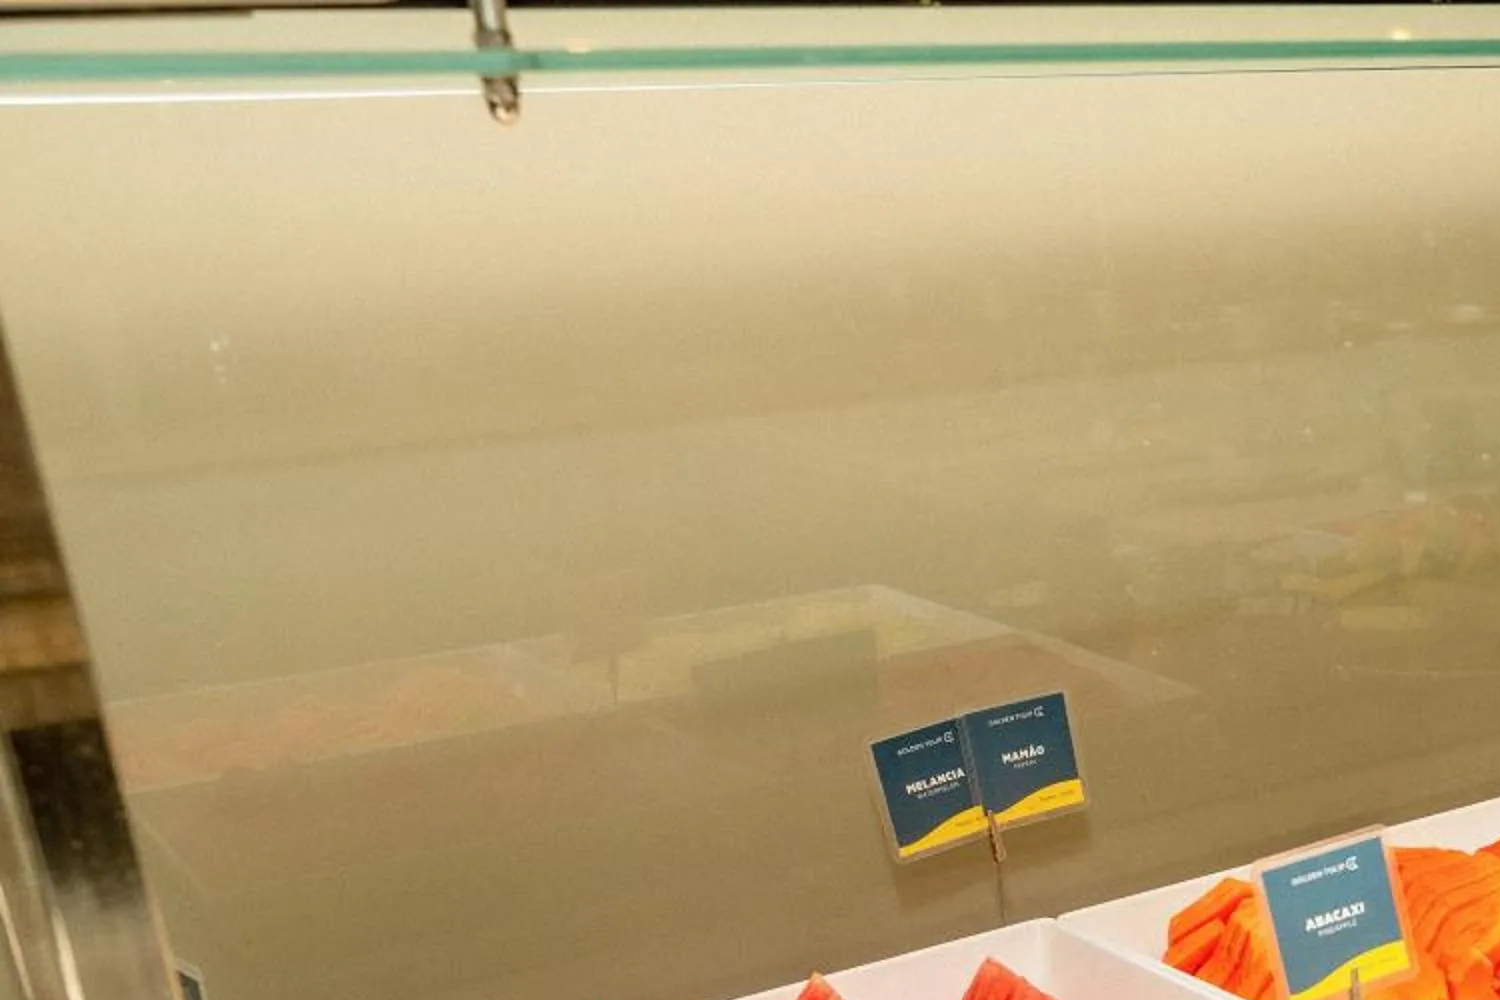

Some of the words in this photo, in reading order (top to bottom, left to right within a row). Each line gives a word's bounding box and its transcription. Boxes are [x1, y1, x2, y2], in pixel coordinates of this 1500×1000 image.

[1000, 743, 1046, 765] MAMÃO
[905, 767, 966, 796] MELANCIA
[1304, 901, 1366, 933] ABACAXI
